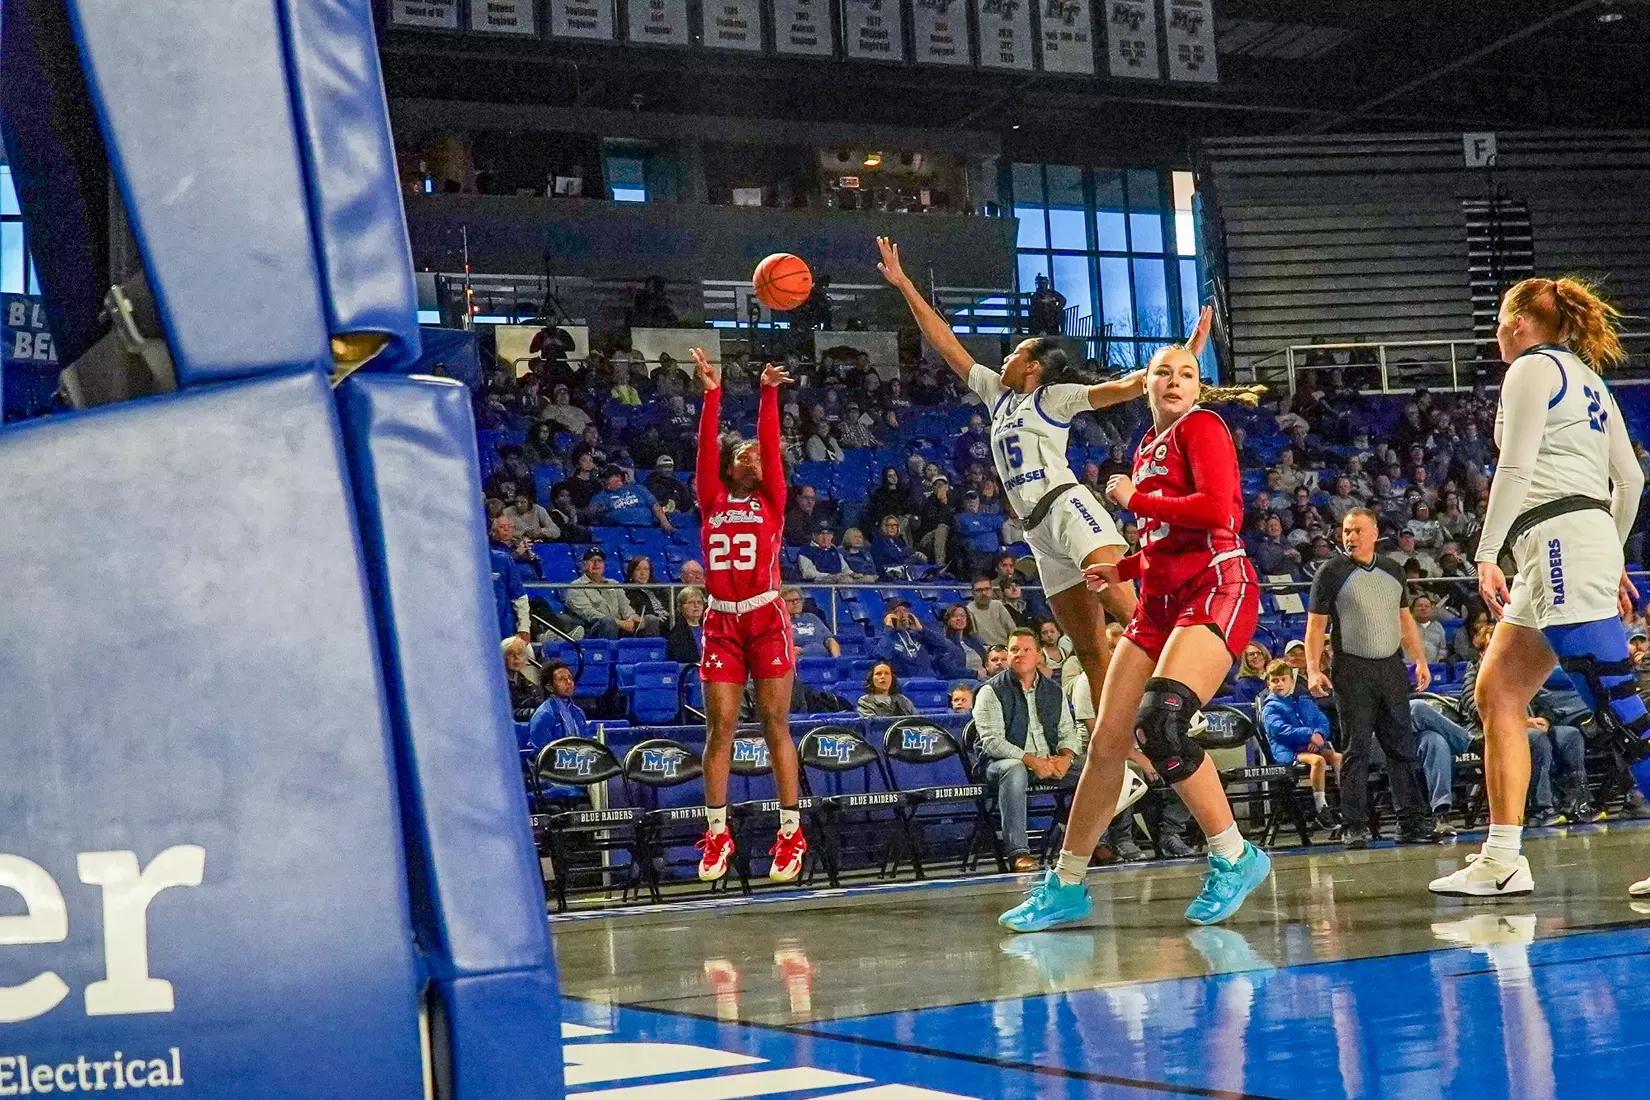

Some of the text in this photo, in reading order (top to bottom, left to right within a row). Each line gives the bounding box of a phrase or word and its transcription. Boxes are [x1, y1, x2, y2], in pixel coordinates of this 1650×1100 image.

[1474, 139, 1487, 160] F
[1069, 497, 1103, 534] RAIDERS
[709, 533, 757, 571] 23
[1547, 538, 1566, 606] RAIDERS
[1204, 713, 1238, 738] MT
[733, 740, 770, 767] MT
[818, 736, 855, 764] MT
[902, 728, 939, 755] MT
[554, 748, 597, 776] MT
[641, 750, 682, 778] MT
[1244, 766, 1287, 778] BLUE RAIDERS
[850, 794, 899, 806] BLUE RAIDERS
[935, 786, 983, 799] BLUE RAIDERS
[581, 811, 634, 822] BLUE RAIDERS
[762, 802, 780, 811] BLUE
[0, 844, 206, 1023] er
[0, 1047, 184, 1096] Electrical
